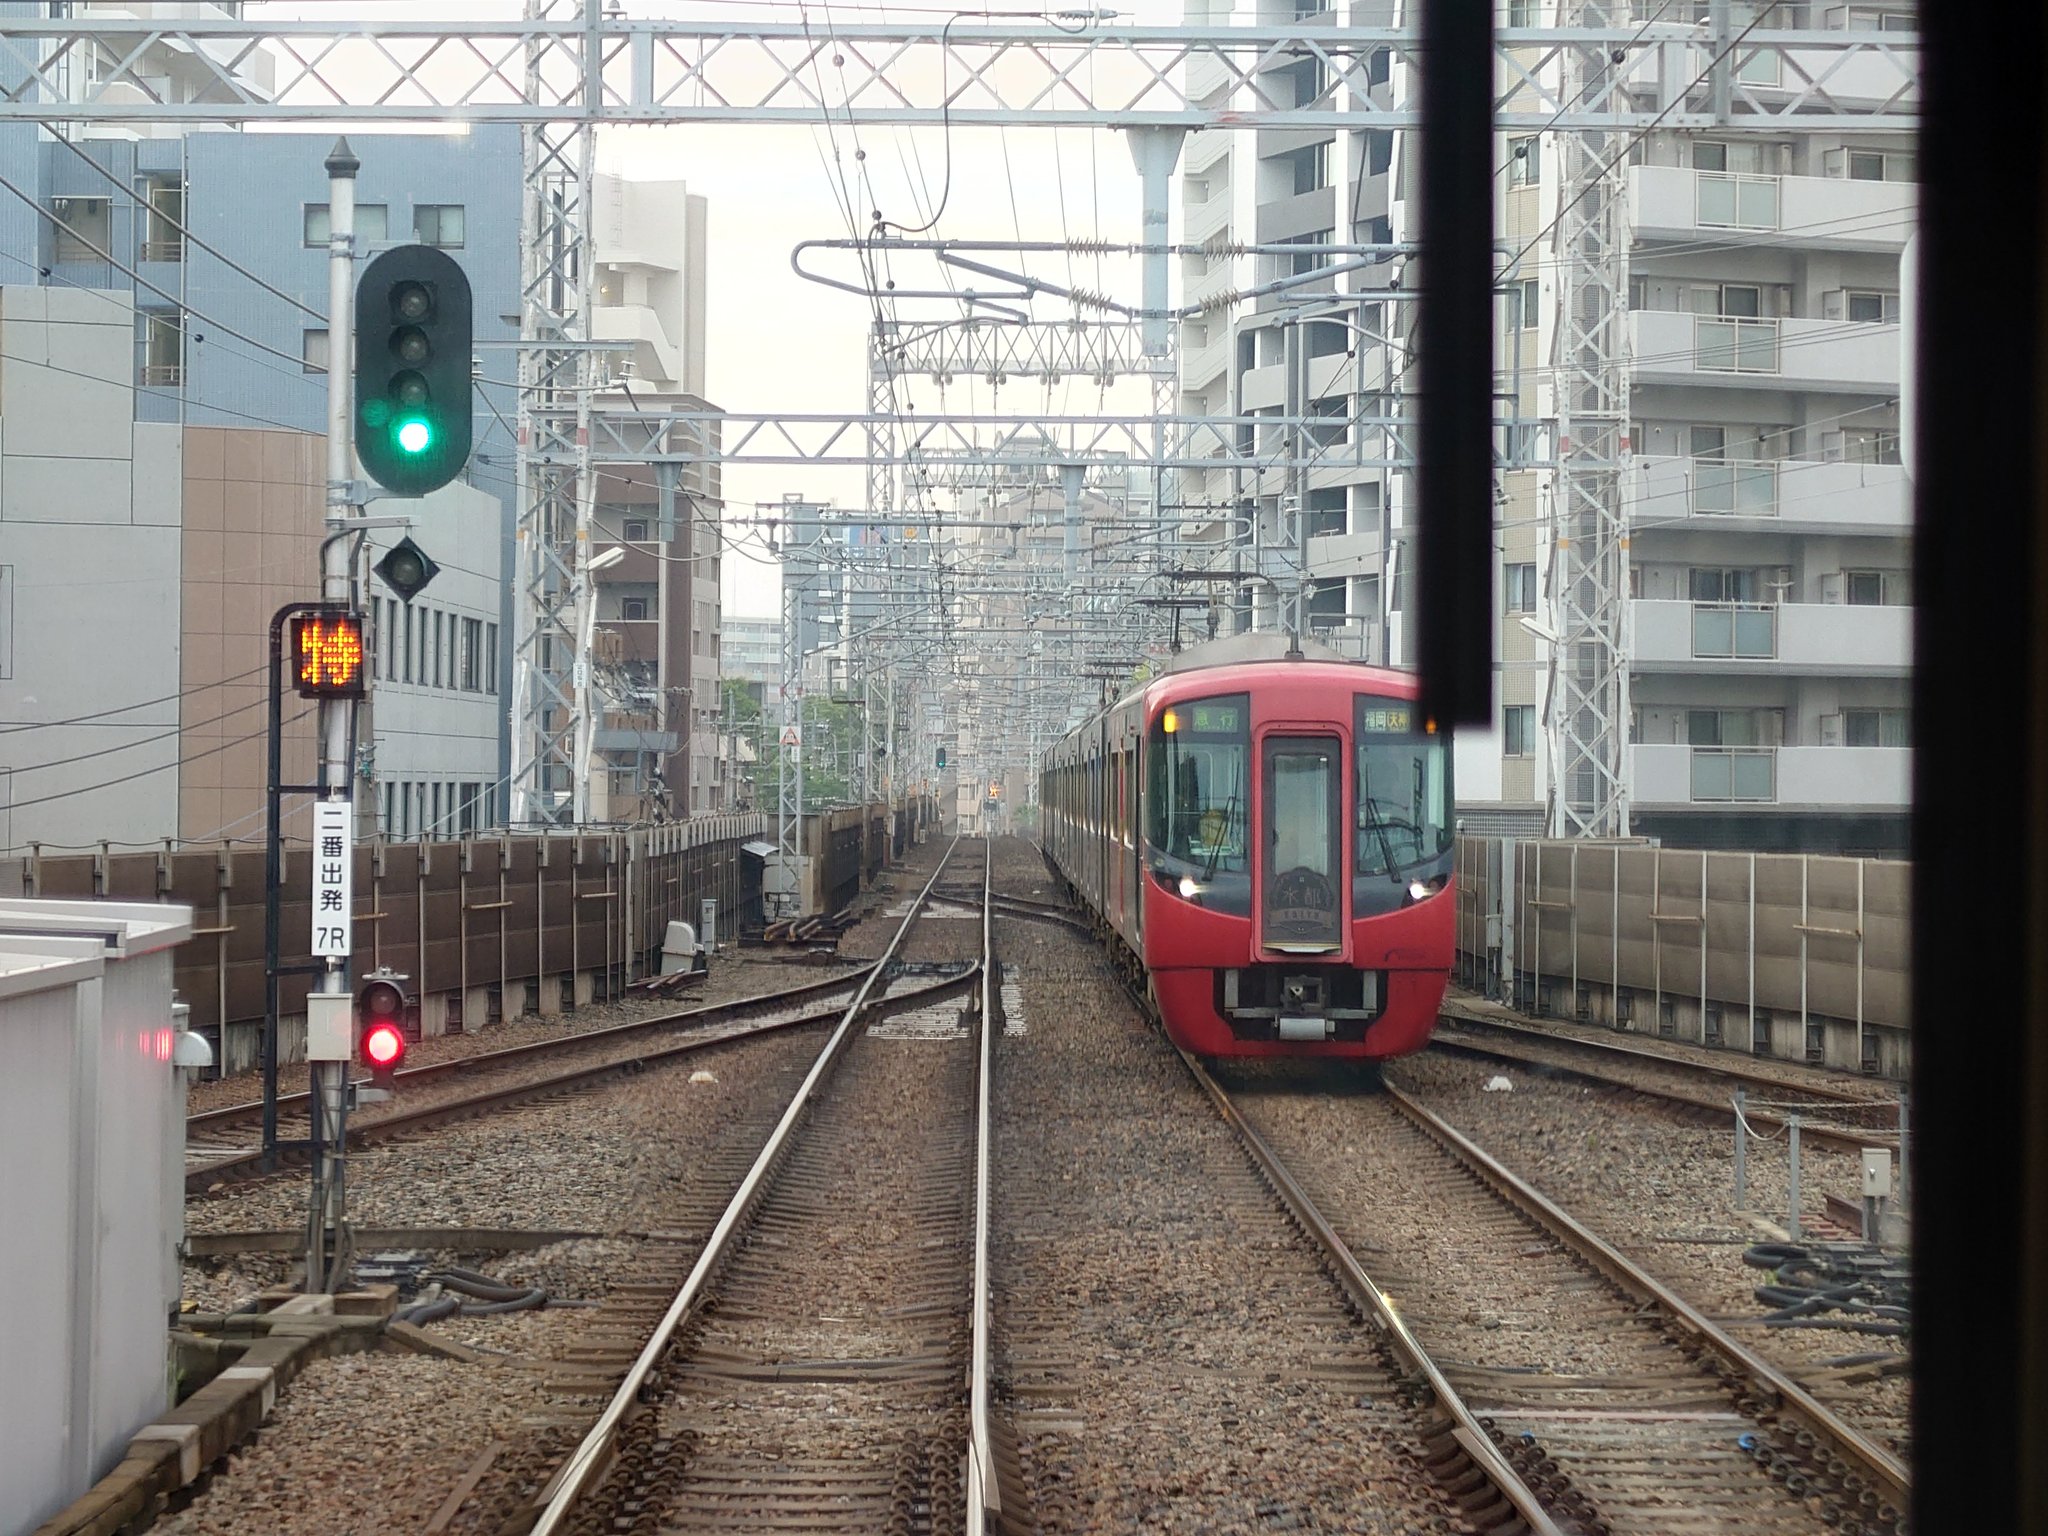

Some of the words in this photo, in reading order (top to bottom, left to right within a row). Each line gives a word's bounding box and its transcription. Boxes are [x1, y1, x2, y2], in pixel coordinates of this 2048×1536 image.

[302, 626, 359, 684] 特
[320, 811, 343, 911] 二番出発
[317, 927, 344, 948] 7R
